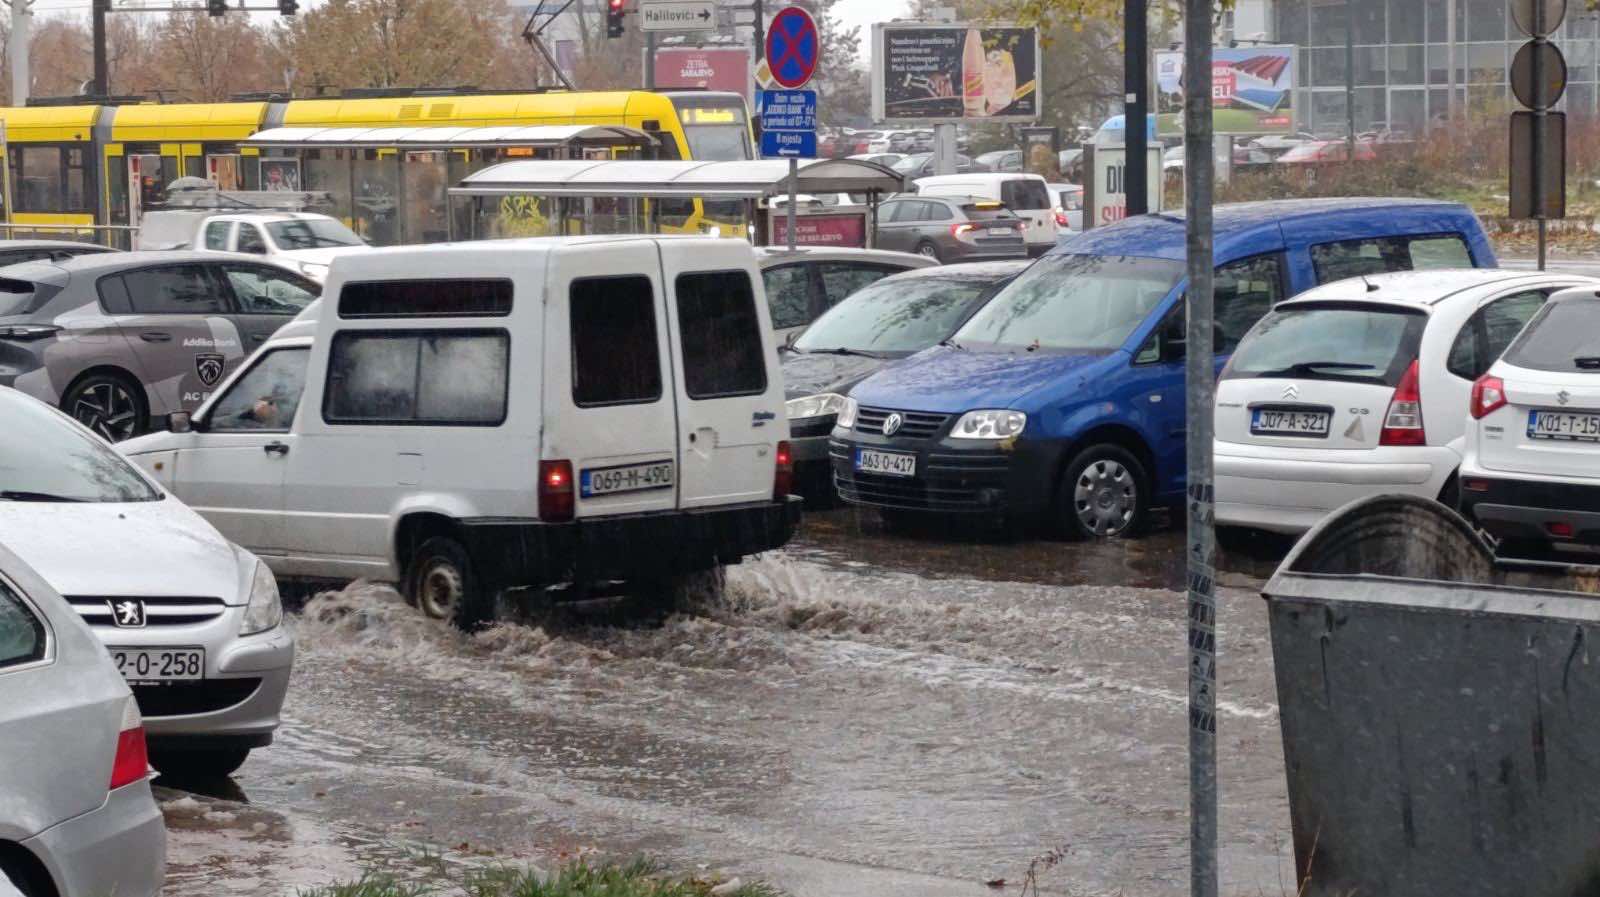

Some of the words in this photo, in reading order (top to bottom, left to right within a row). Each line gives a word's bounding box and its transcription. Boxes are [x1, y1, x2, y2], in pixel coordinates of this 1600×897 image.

[781, 134, 802, 145] mjesta
[1106, 165, 1126, 194] DI
[183, 391, 201, 401] AC
[1348, 407, 1370, 415] C3
[1260, 411, 1325, 432] J07-A-321
